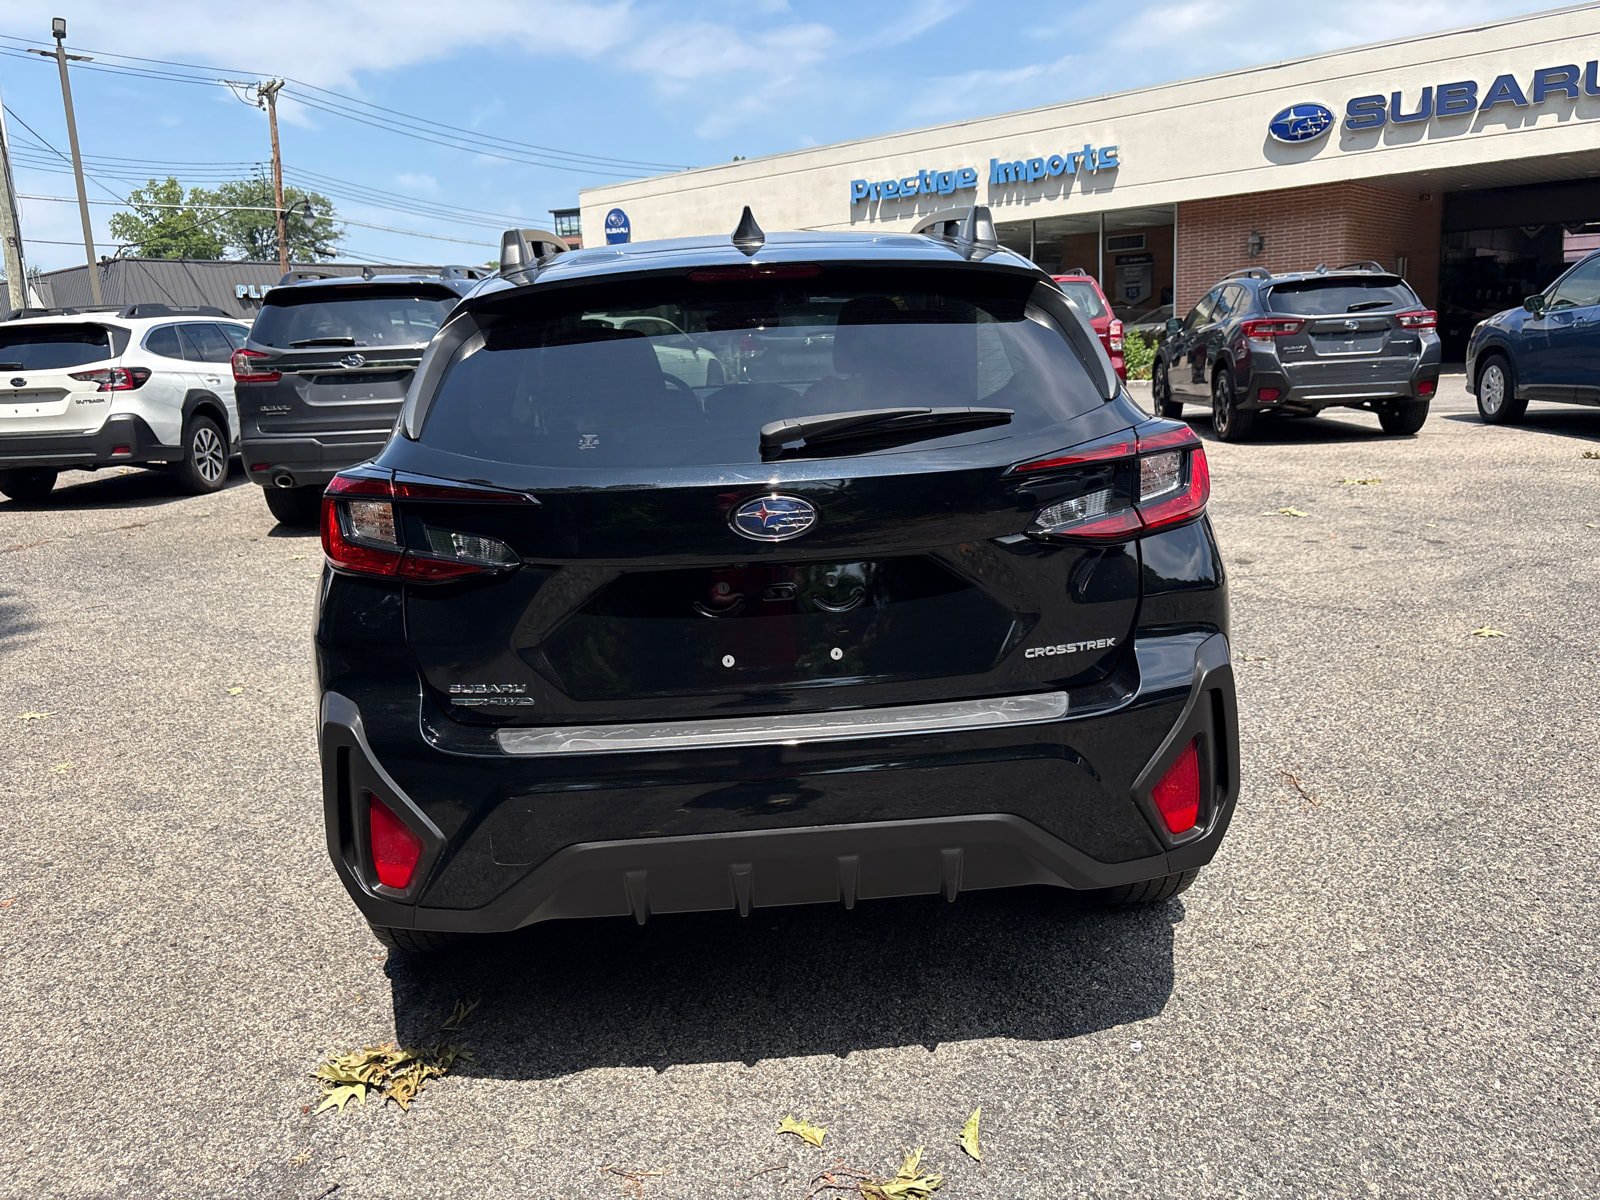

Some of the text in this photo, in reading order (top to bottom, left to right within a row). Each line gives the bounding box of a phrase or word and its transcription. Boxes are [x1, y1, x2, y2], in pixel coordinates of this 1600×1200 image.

[850, 143, 1120, 205] Prestige Imports
[1024, 637, 1116, 659] CROSSTREK
[449, 684, 526, 693] SUBARU
